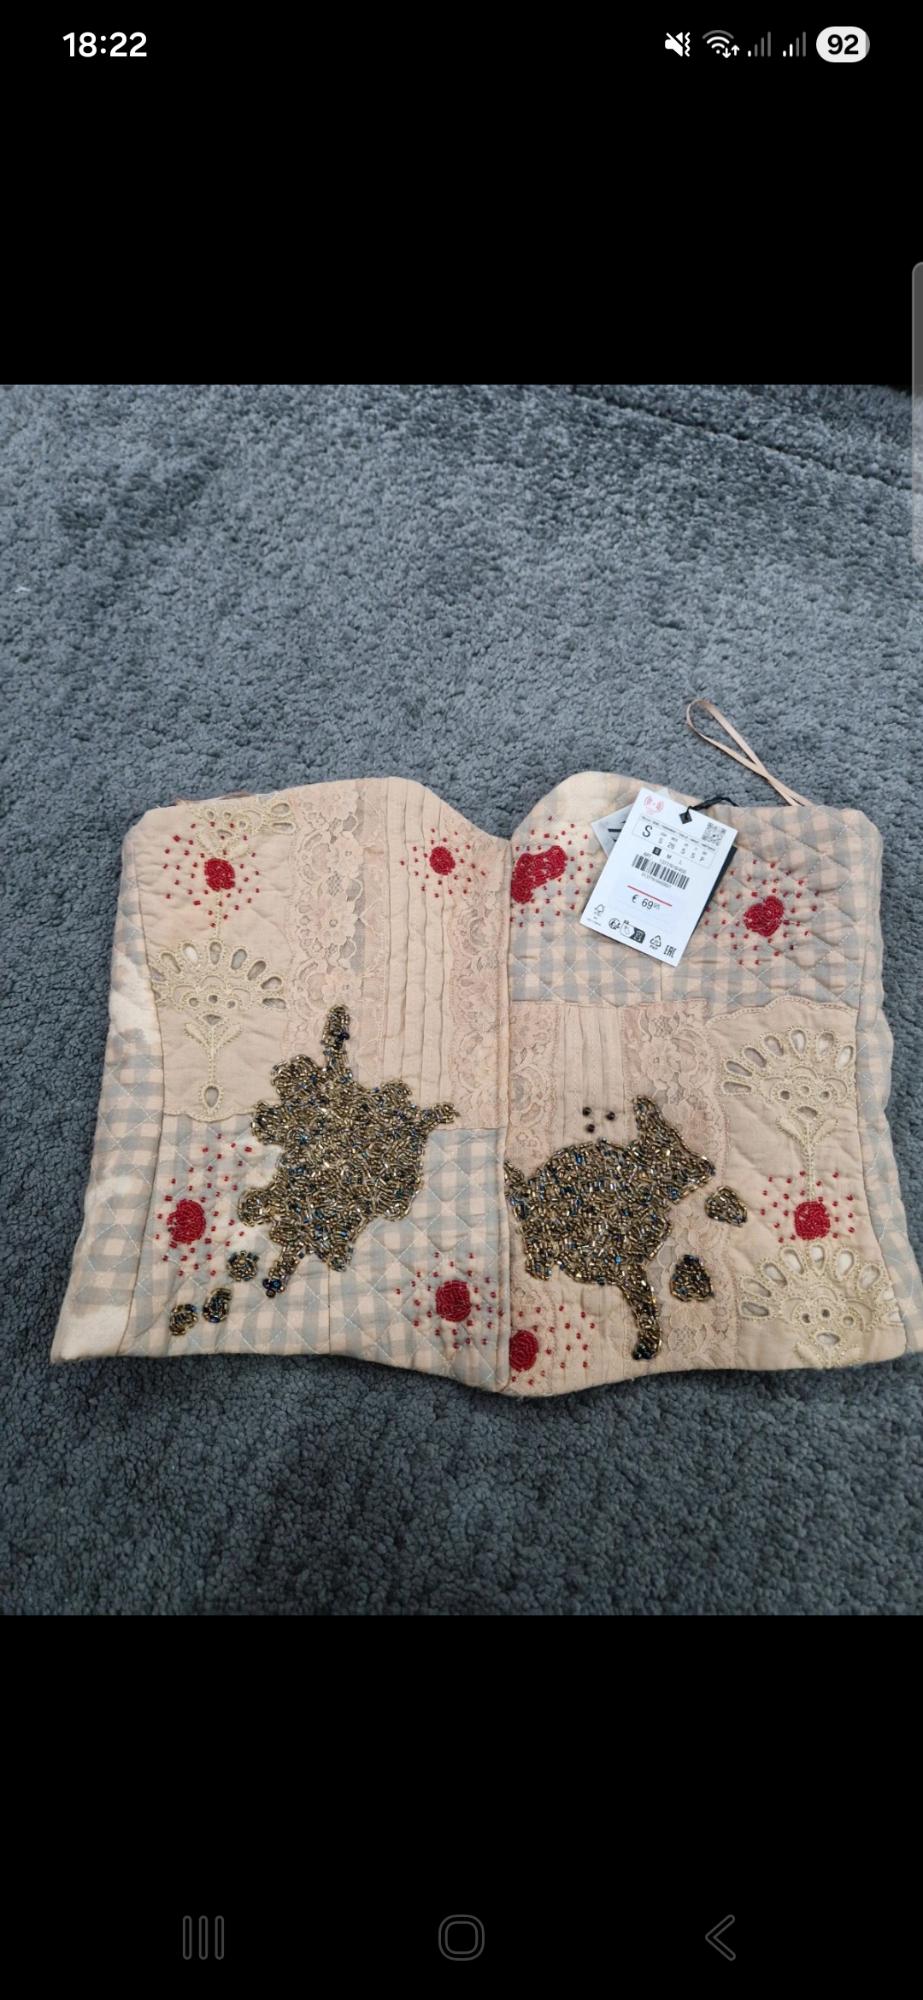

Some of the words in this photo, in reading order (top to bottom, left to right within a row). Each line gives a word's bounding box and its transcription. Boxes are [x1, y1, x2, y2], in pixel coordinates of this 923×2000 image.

[63, 32, 147, 57] 18:22
[828, 34, 859, 55] 92
[642, 824, 653, 838] S
[632, 894, 638, 904] €
